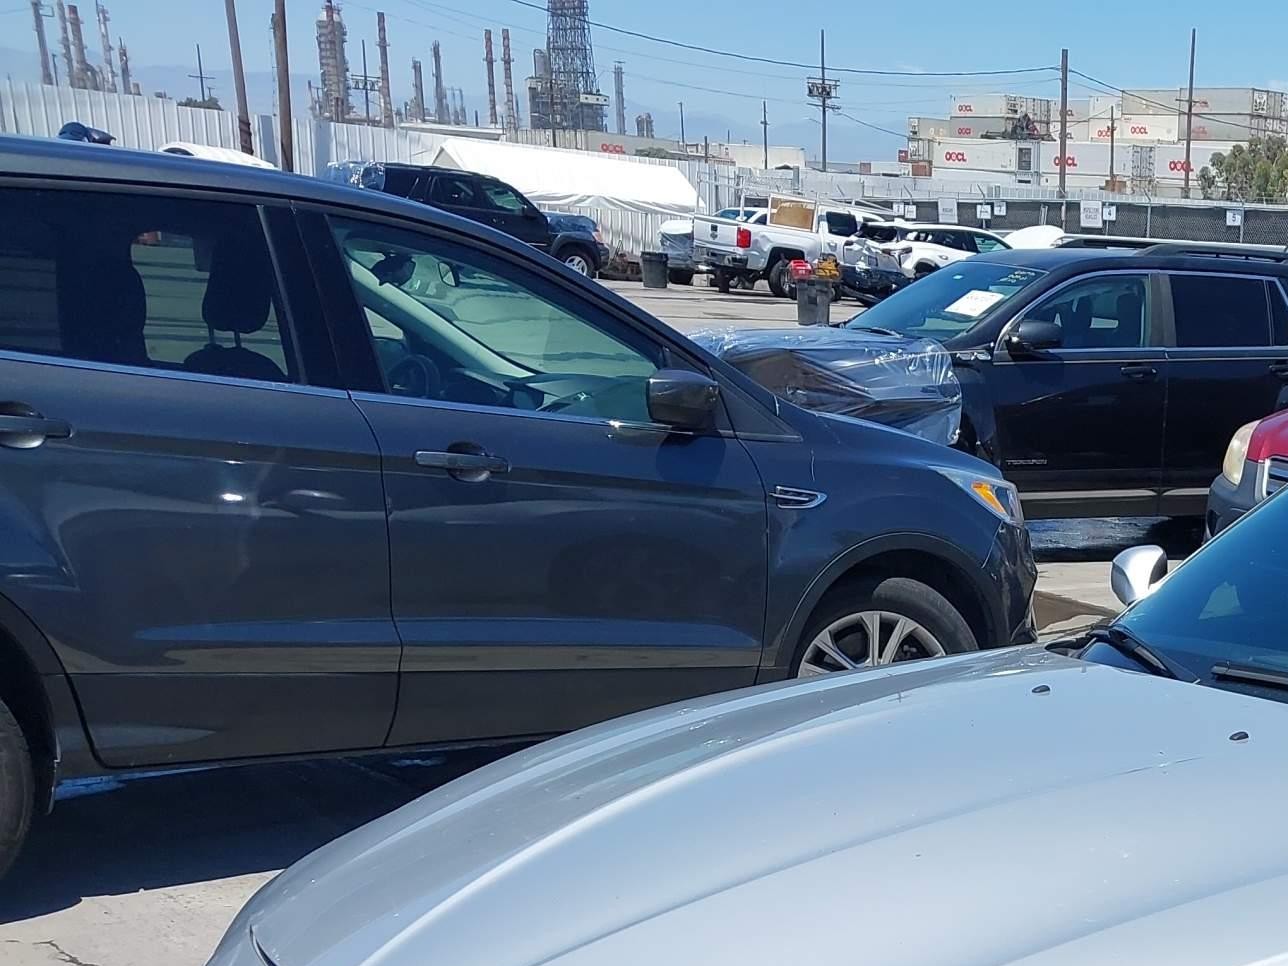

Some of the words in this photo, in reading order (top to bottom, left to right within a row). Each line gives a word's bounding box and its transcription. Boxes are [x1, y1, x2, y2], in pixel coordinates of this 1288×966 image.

[1130, 126, 1149, 135] OOCL
[944, 151, 968, 163] OOCL
[1053, 156, 1078, 168] OCL
[1231, 213, 1237, 222] 5
